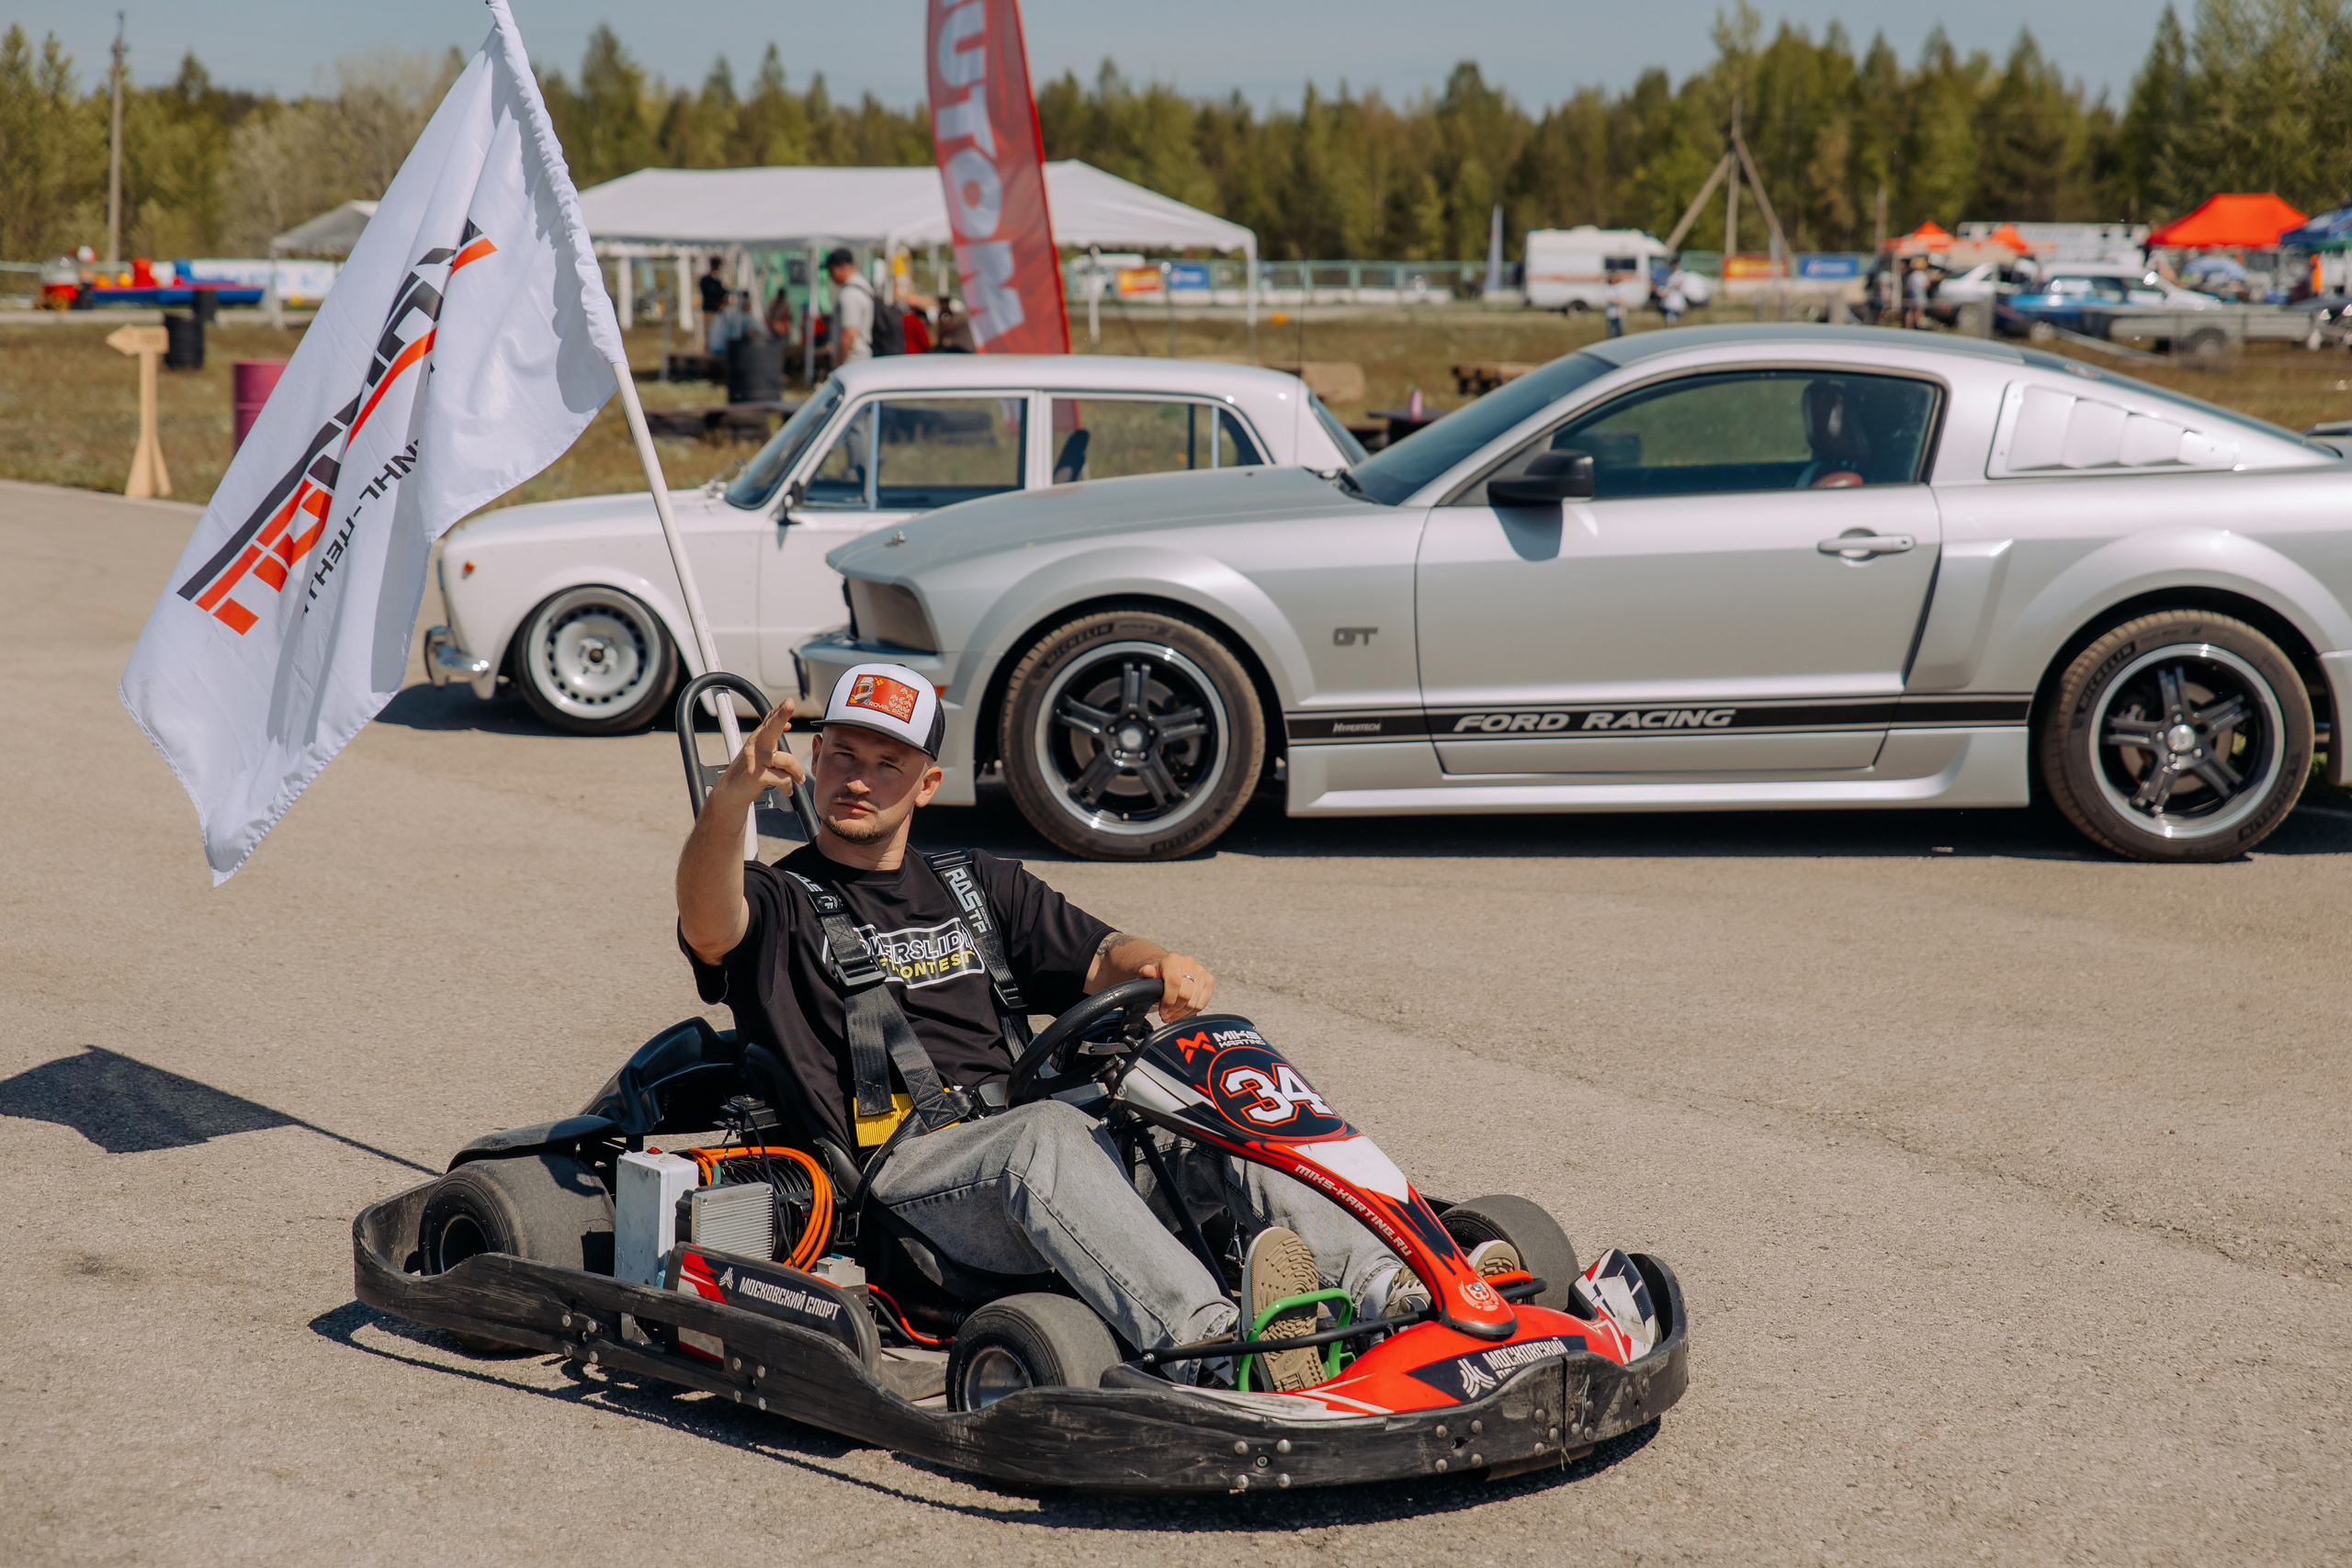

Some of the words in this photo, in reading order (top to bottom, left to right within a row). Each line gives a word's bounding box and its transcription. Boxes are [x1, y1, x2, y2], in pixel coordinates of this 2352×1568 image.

[1333, 627, 1378, 646] GT
[868, 701, 890, 712] ROYAL
[891, 706, 909, 719] RACE
[1453, 712, 1571, 733] FORD
[1580, 707, 1736, 730] RACING
[1212, 1030, 1262, 1043] MIKS
[1218, 1038, 1267, 1049] KARTING
[1222, 1065, 1335, 1124] 34
[1294, 1164, 1413, 1257] MIKS-KARTING.RU
[738, 1276, 808, 1312] МОСКОВСКИЙ
[804, 1295, 842, 1322] СПОРТ
[1481, 1337, 1569, 1371] МОСКОВСКИЙ
